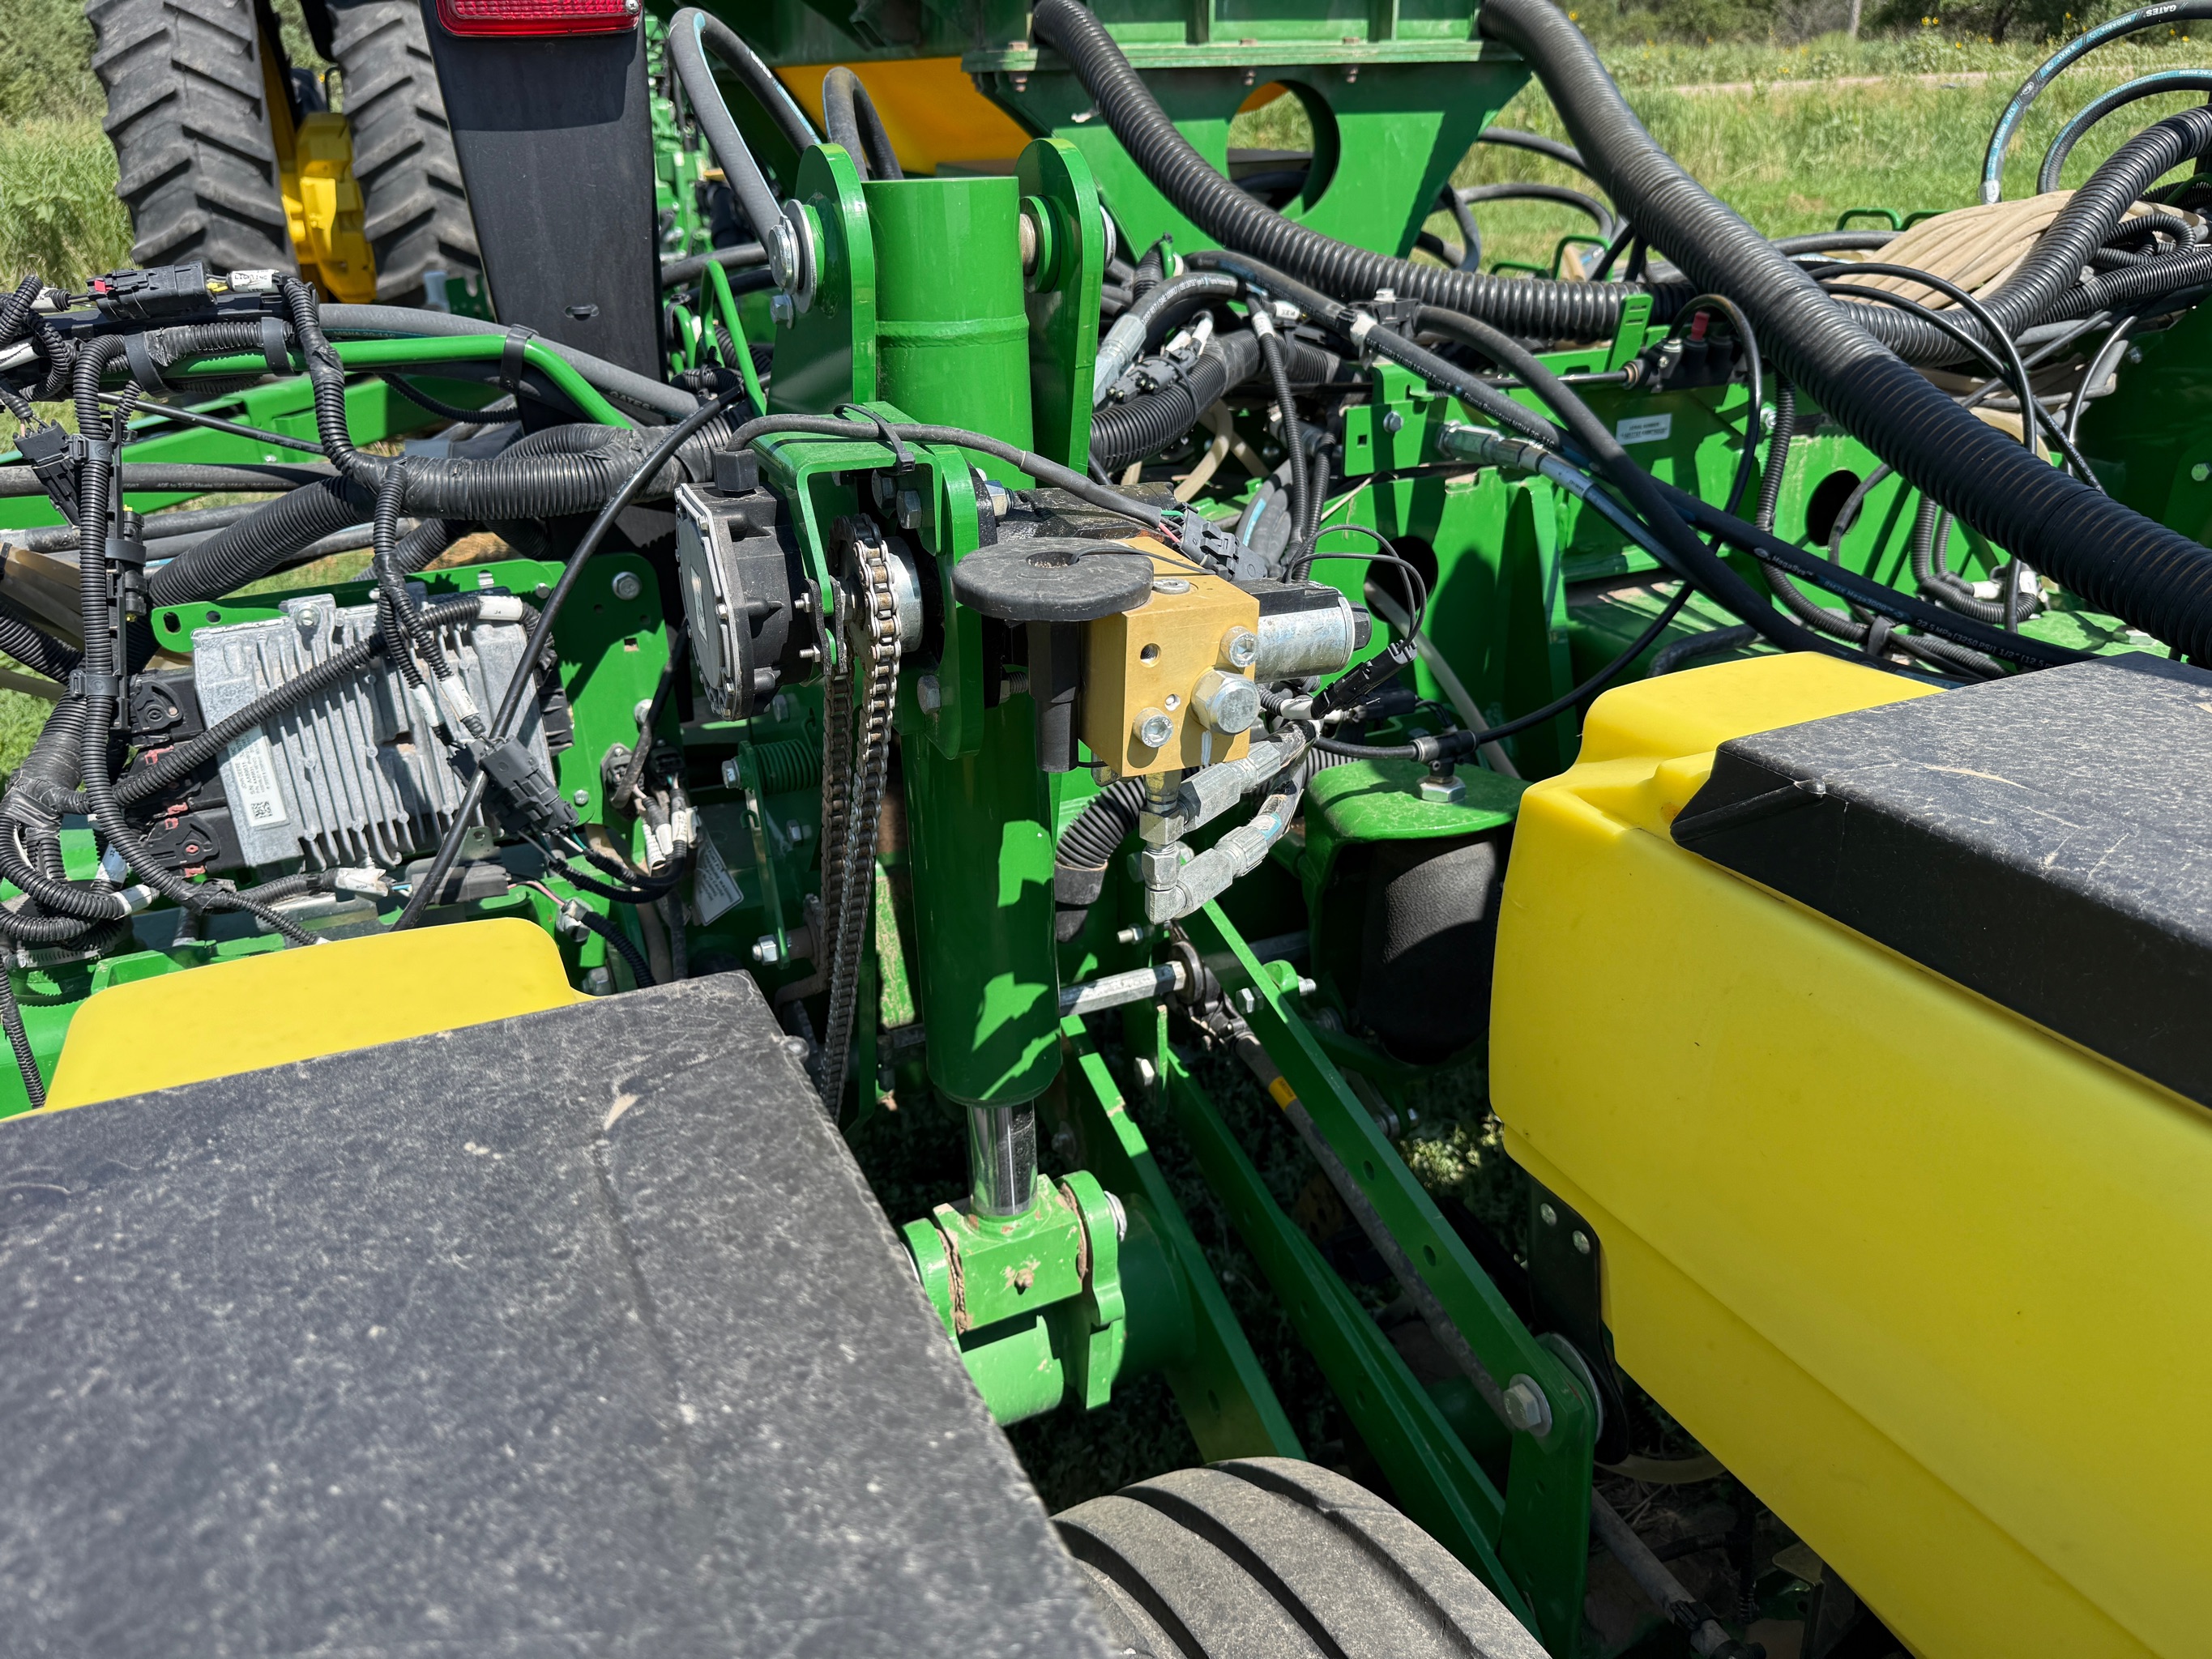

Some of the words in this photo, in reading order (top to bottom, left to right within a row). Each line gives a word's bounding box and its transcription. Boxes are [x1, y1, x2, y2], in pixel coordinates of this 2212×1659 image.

[2145, 3, 2177, 17] GATES
[1364, 337, 1377, 347] SAE
[1430, 373, 1445, 386] Type
[1463, 392, 1483, 407] Flame
[1481, 403, 1513, 424] Resistant
[1510, 419, 1531, 435] MSHA
[1915, 618, 1936, 632] 22.5
[1934, 625, 1953, 638] MPa
